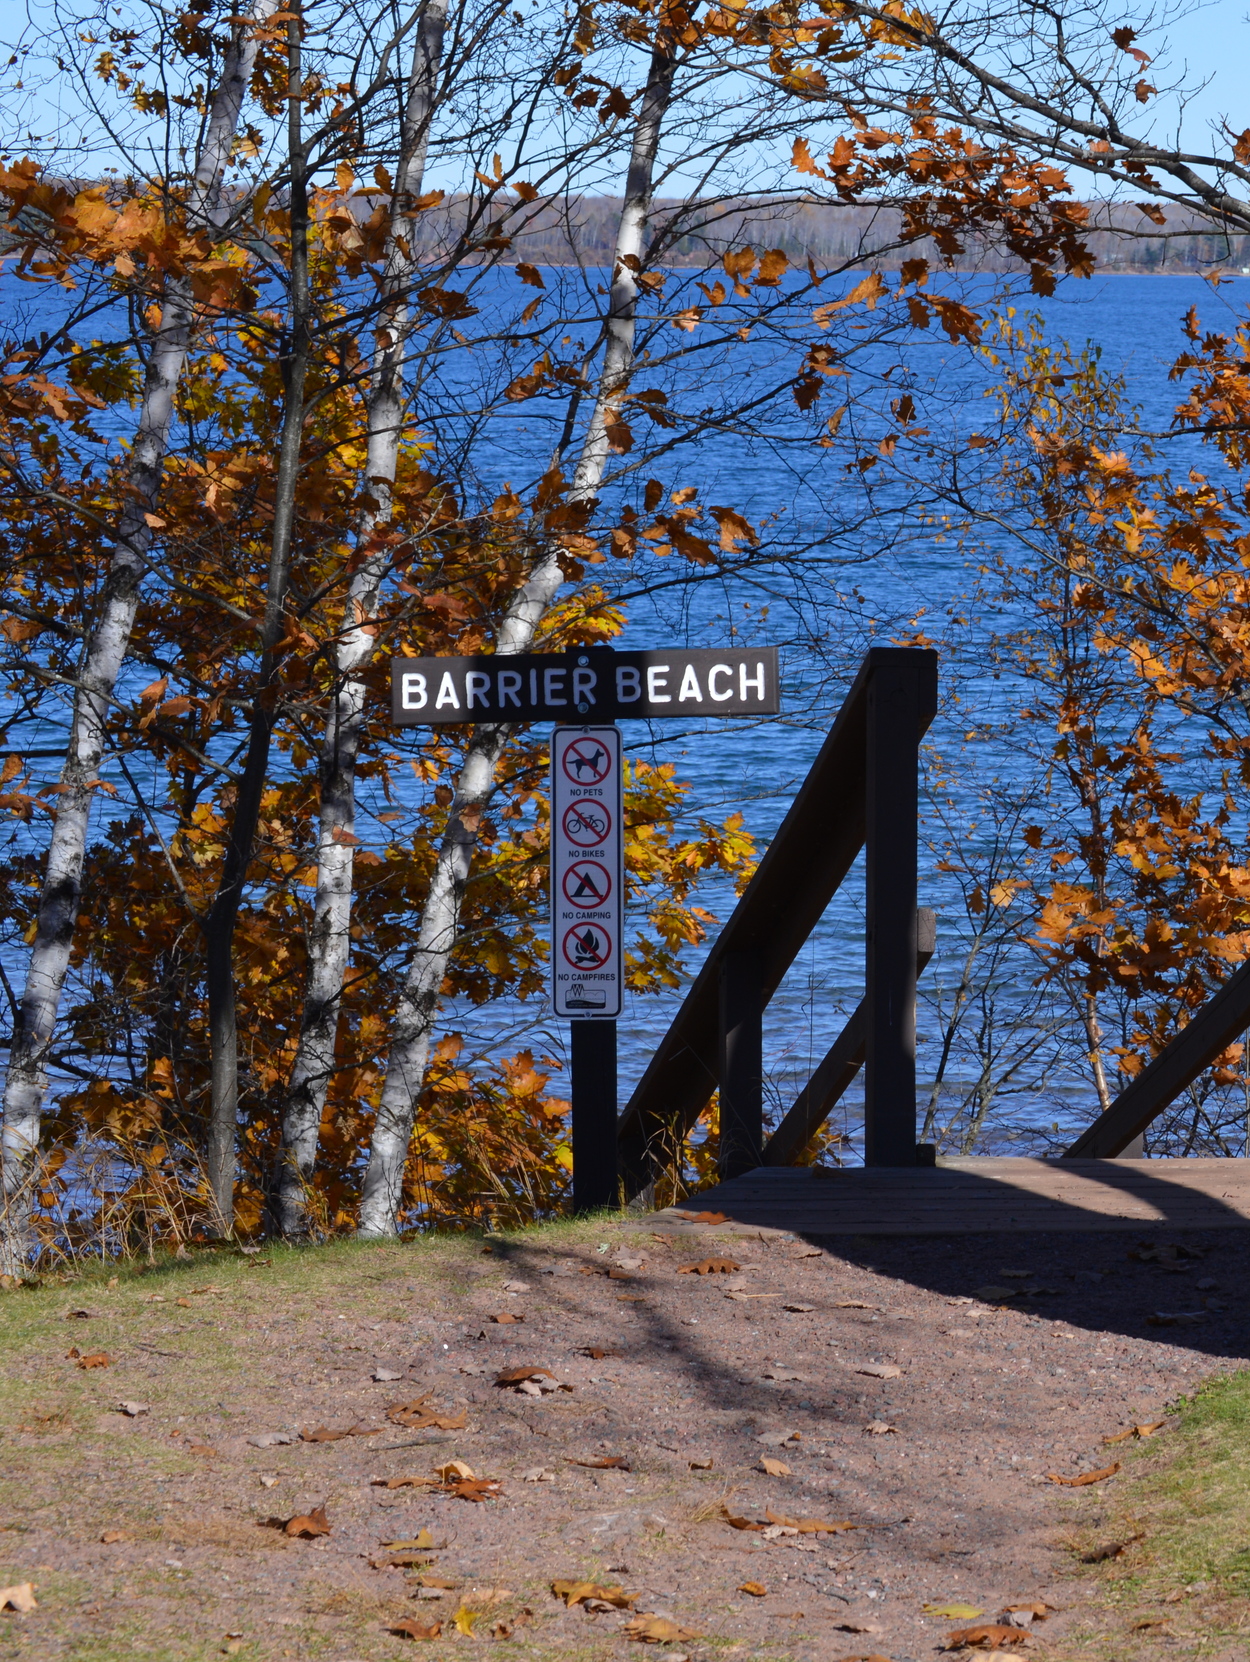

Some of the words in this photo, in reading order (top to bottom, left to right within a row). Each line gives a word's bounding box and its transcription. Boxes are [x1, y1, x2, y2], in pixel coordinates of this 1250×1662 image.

[401, 666, 597, 710] BARRIER
[616, 662, 766, 704] BEACH
[570, 788, 581, 796] NO
[583, 788, 603, 796] PETS
[568, 850, 580, 858] NO
[571, 973, 616, 981] CAMPFIRES
